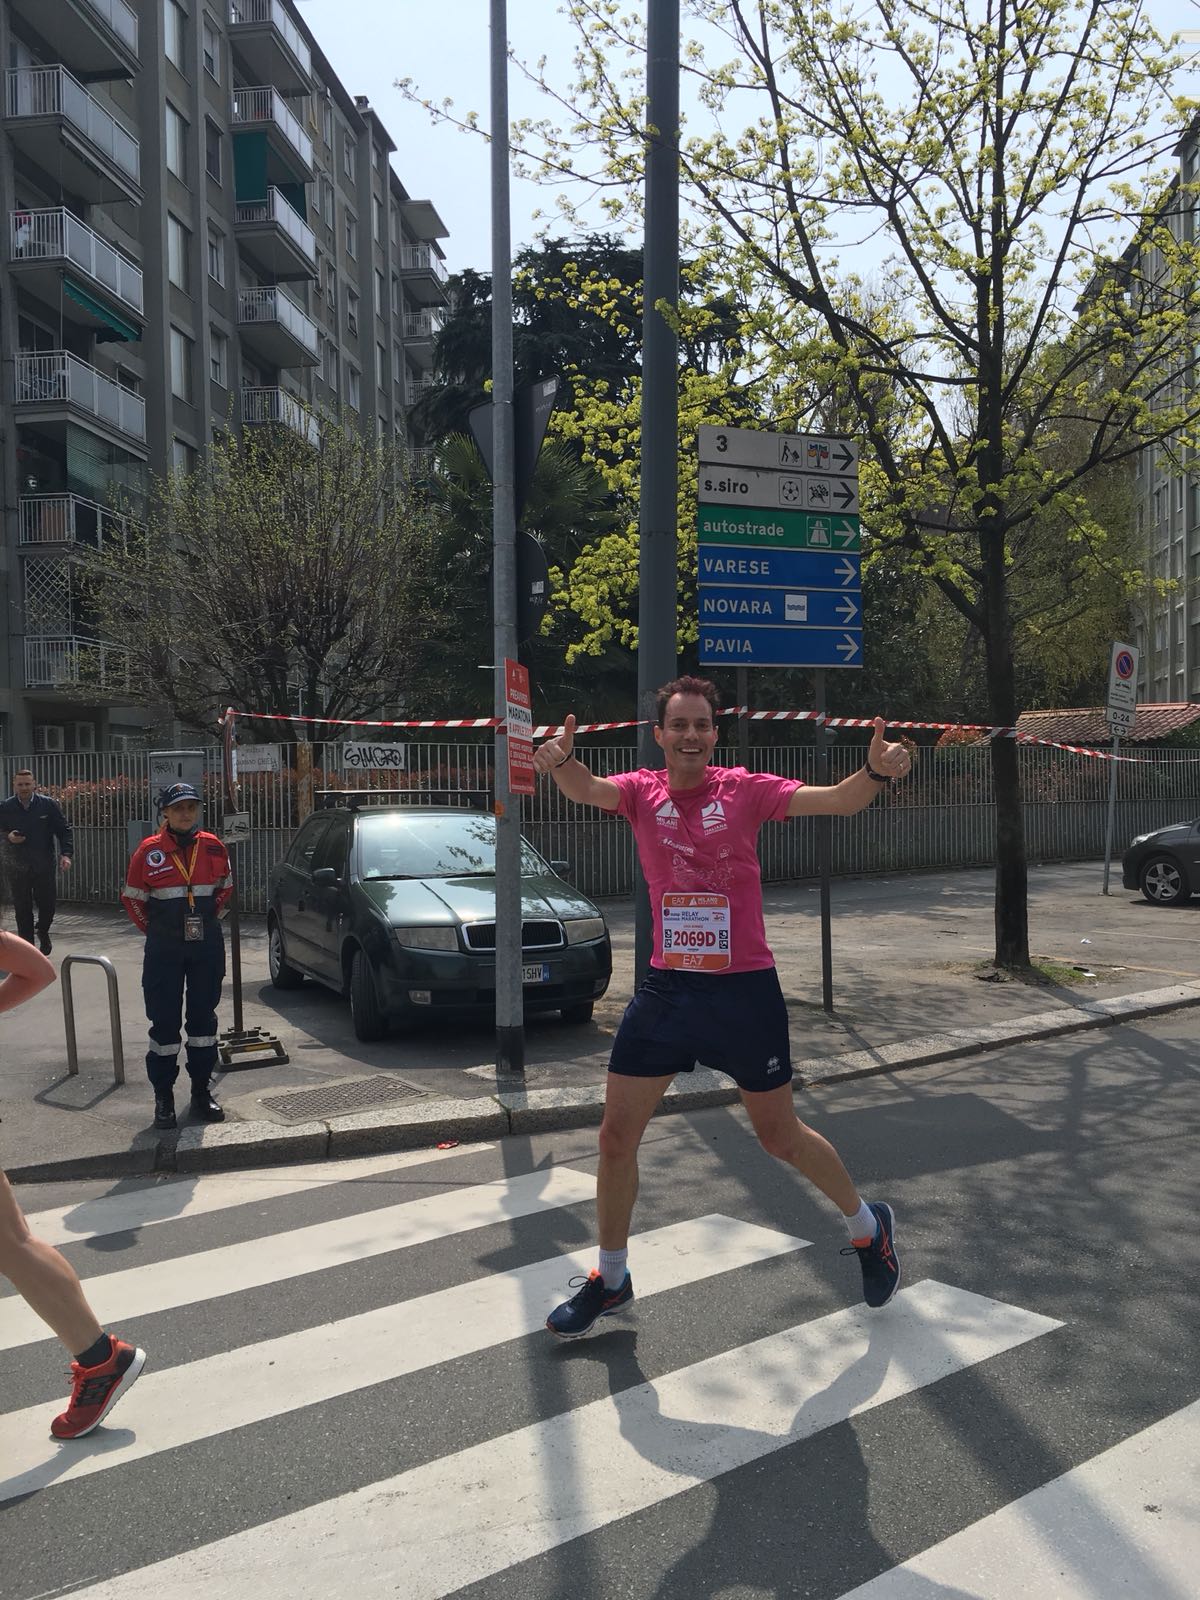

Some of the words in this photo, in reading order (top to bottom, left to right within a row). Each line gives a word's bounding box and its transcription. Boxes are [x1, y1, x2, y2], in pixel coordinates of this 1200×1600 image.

[716, 434, 728, 453] 3
[704, 478, 749, 494] s.siro
[703, 519, 784, 536] autostrade
[703, 558, 770, 575] VARESE
[703, 599, 773, 615] NOVARA
[704, 638, 753, 653] PAVIA
[508, 705, 531, 725] MARATONA
[1113, 711, 1129, 722] 0-24
[673, 930, 716, 947] 2069D
[682, 954, 705, 966] EA7
